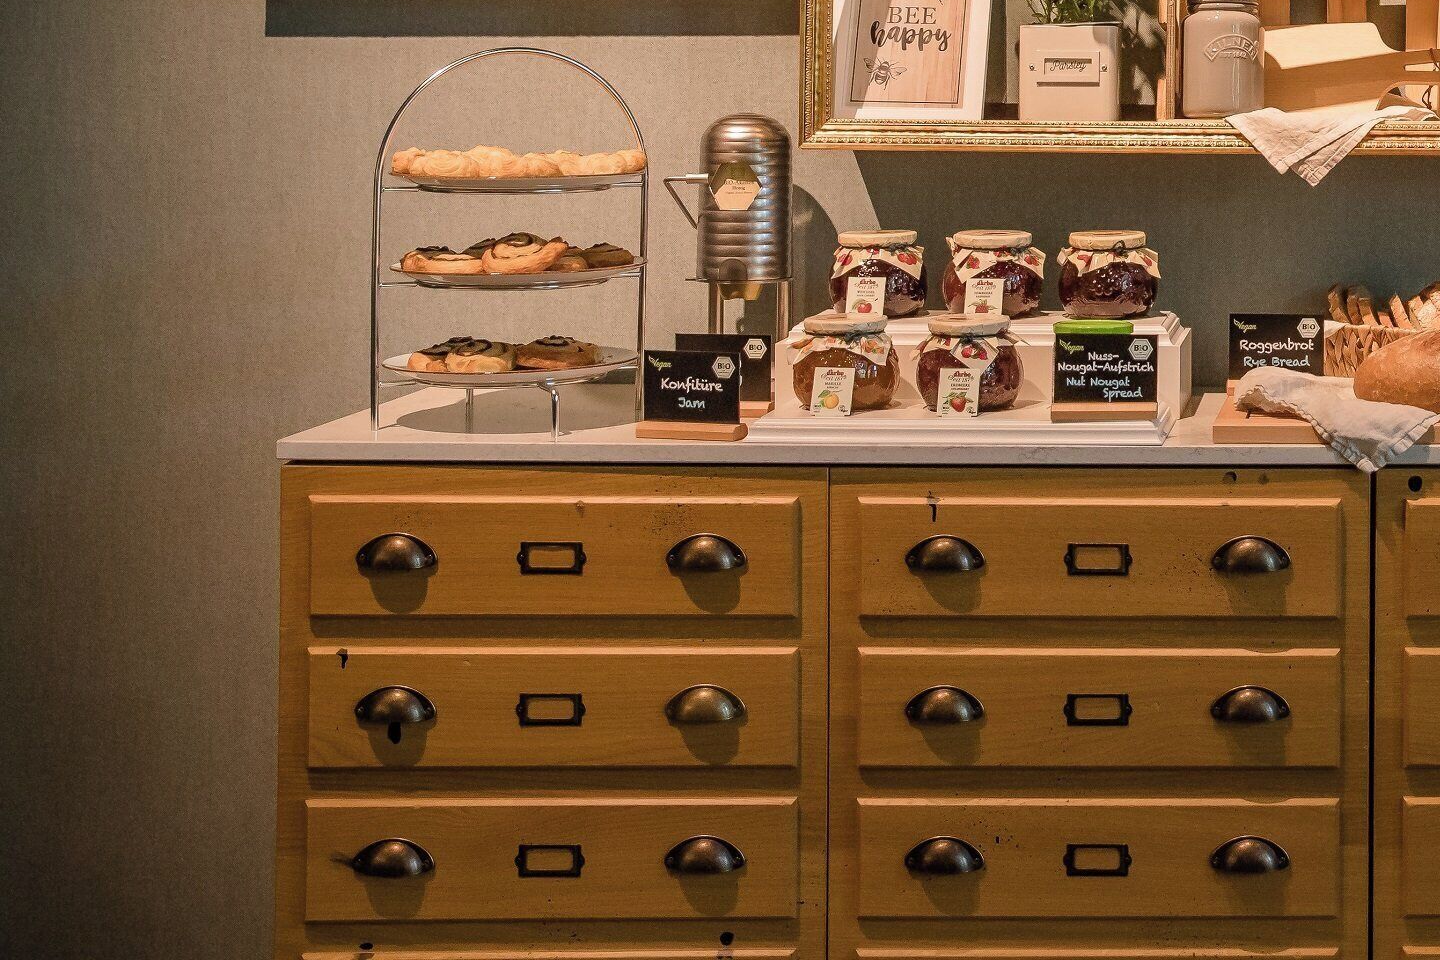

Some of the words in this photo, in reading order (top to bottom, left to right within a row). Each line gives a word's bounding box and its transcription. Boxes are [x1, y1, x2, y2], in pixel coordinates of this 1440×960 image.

[887, 6, 937, 25] BEE
[870, 20, 952, 51] happy
[1049, 59, 1087, 72] Parsley
[1240, 338, 1314, 354] Roggenbrot
[649, 356, 672, 371] Vegan
[1088, 351, 1120, 361] Nuss-
[1243, 356, 1267, 368] Rye
[1271, 355, 1311, 367] Bread
[1057, 360, 1155, 374] Nougat-Aufstrich
[661, 376, 723, 393] Konfitüre
[1066, 375, 1086, 386] Nut
[1090, 376, 1130, 390] Nougat
[1102, 386, 1143, 402] Spread
[678, 397, 706, 409] Jam
